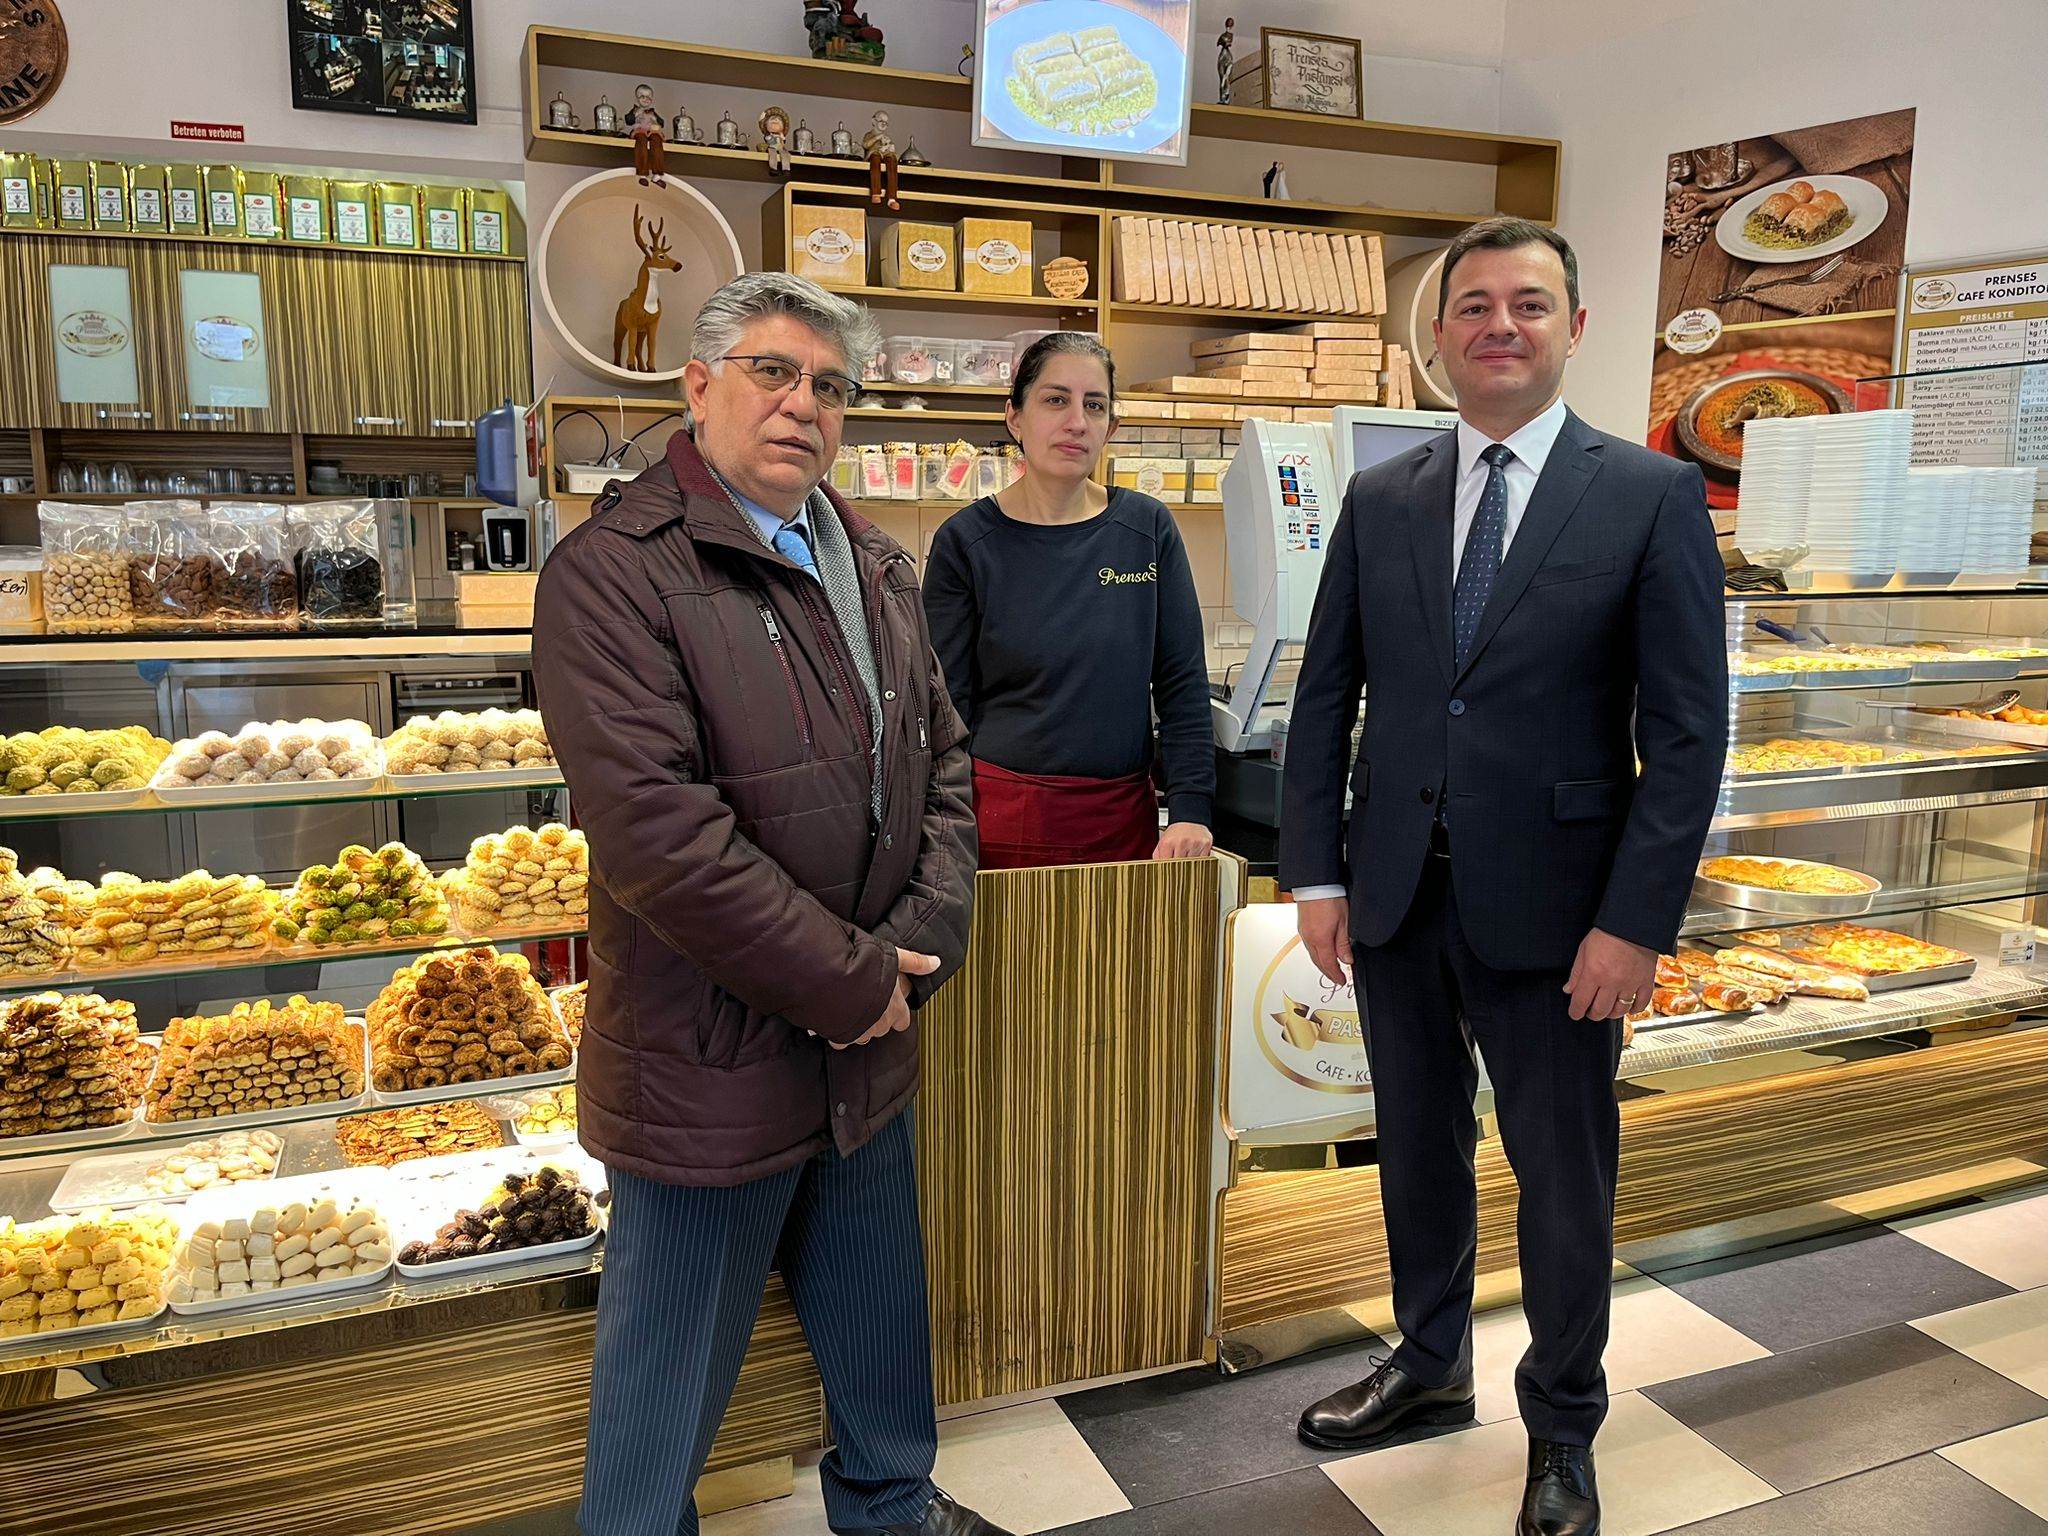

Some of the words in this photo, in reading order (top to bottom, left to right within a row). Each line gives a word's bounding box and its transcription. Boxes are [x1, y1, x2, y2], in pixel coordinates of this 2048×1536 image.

[173, 124, 207, 138] Betreten
[208, 127, 242, 139] verboten
[1985, 272, 2037, 286] PRENSES
[1957, 291, 1985, 302] CAFE
[1959, 311, 2014, 322] PREISLISTE
[1278, 454, 1311, 466] SIX
[1316, 1060, 1345, 1081] CAFE
